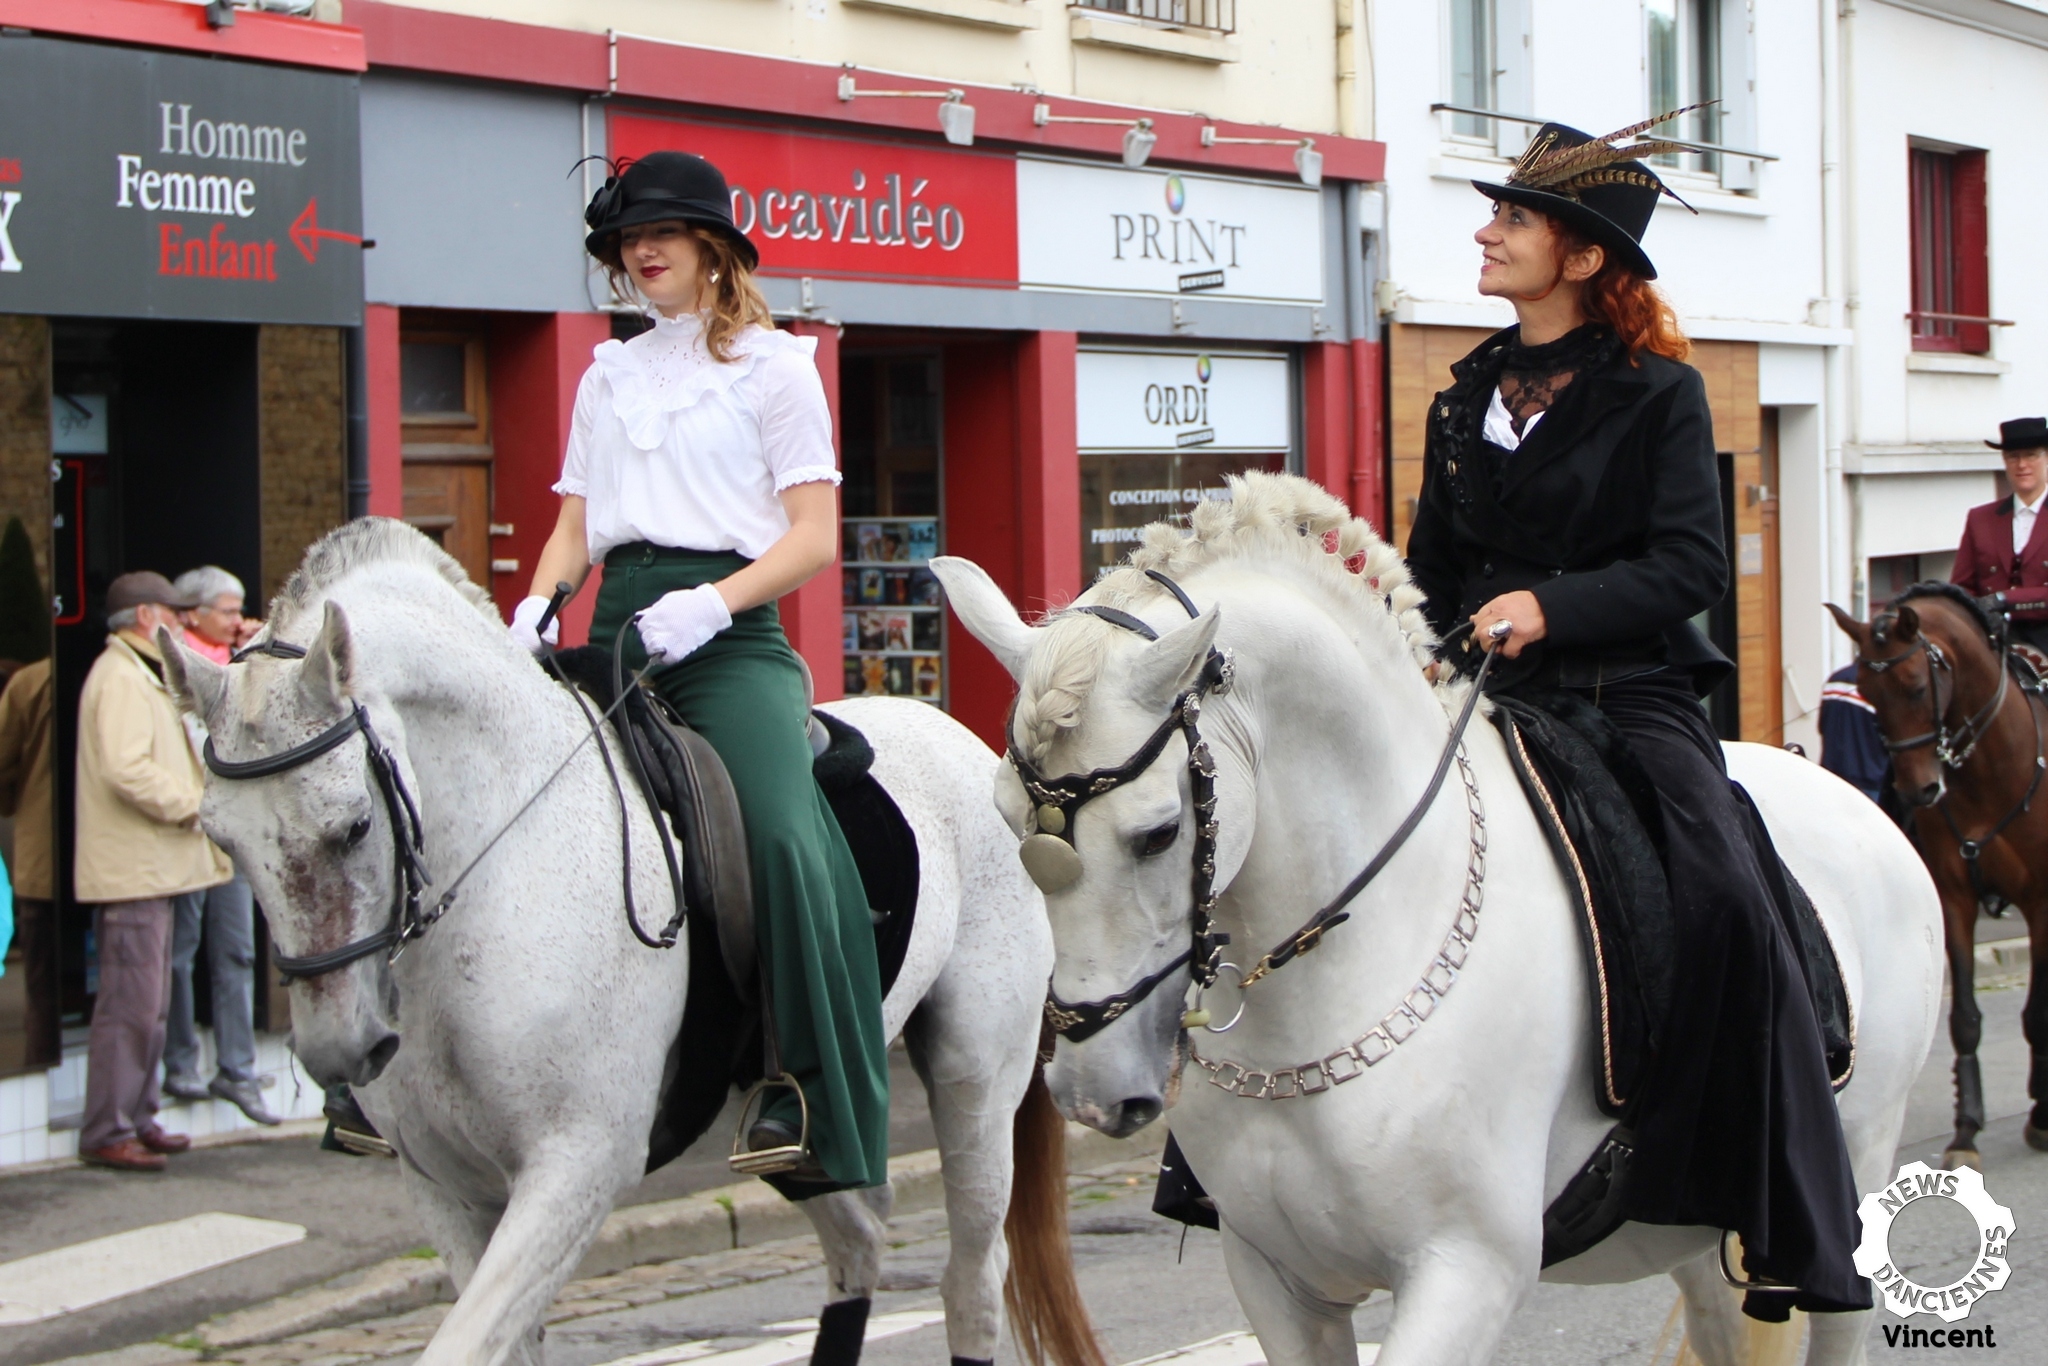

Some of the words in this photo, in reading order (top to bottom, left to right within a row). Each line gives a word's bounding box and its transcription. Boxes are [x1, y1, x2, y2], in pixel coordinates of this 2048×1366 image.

[159, 102, 307, 166] Homme
[116, 154, 256, 218] Femme
[728, 168, 965, 251] ocavidéo
[158, 222, 278, 282] Enfant
[1109, 488, 1181, 506] CONCEPTION
